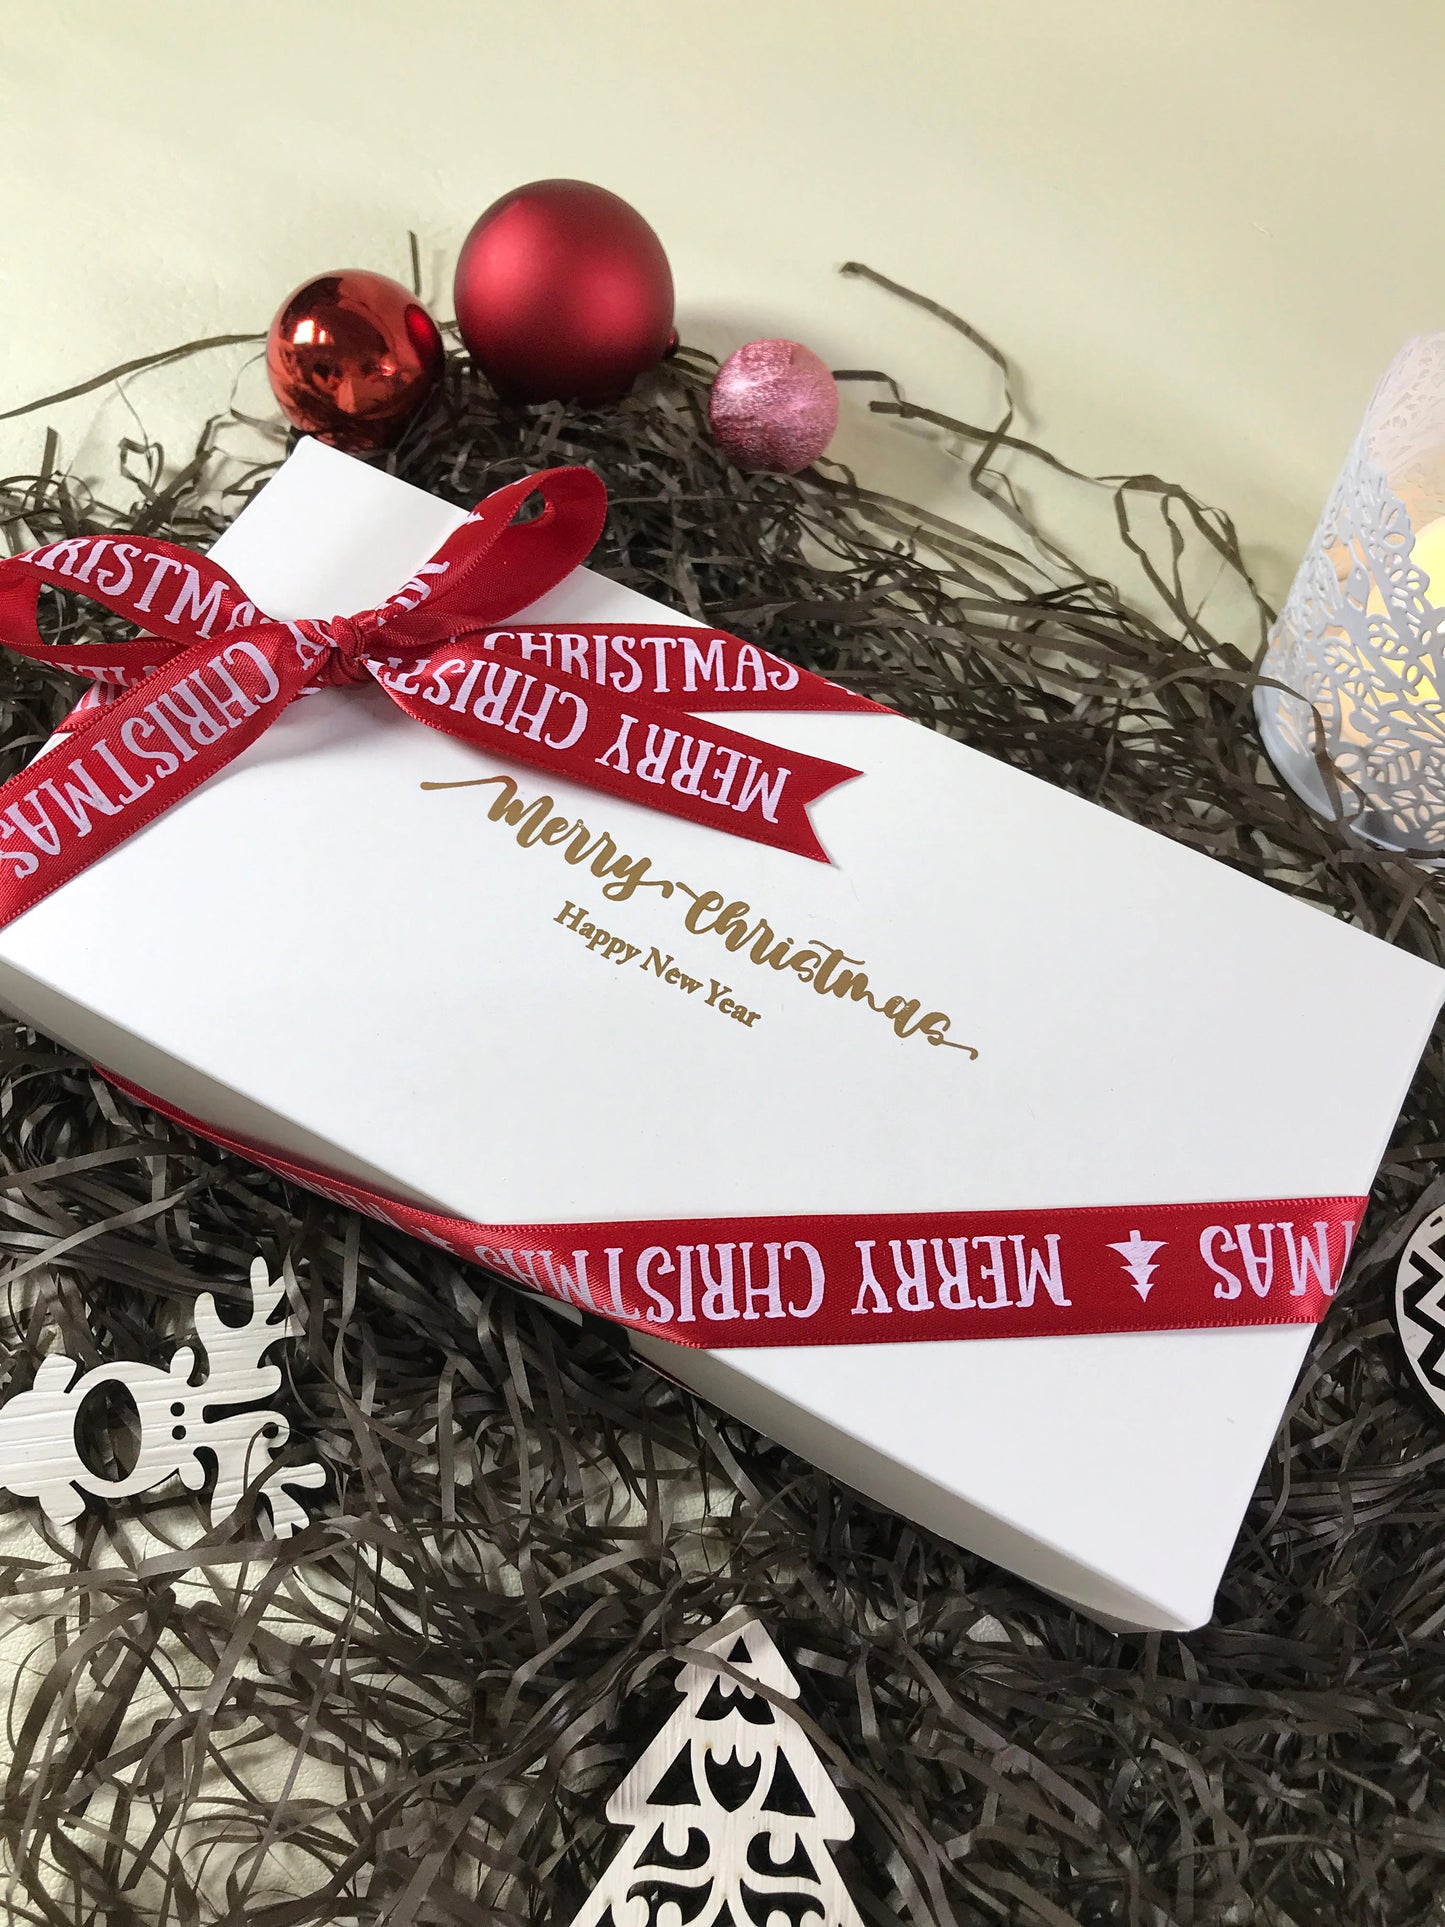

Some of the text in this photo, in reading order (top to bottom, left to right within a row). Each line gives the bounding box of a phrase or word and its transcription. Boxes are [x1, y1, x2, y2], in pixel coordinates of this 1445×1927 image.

[595, 712, 793, 826] MERRY
[419, 774, 674, 902] Merry
[553, 900, 762, 1029] Happy New Year
[473, 1240, 826, 1324] CHRISTMAS
[850, 1232, 1073, 1318] MERRY
